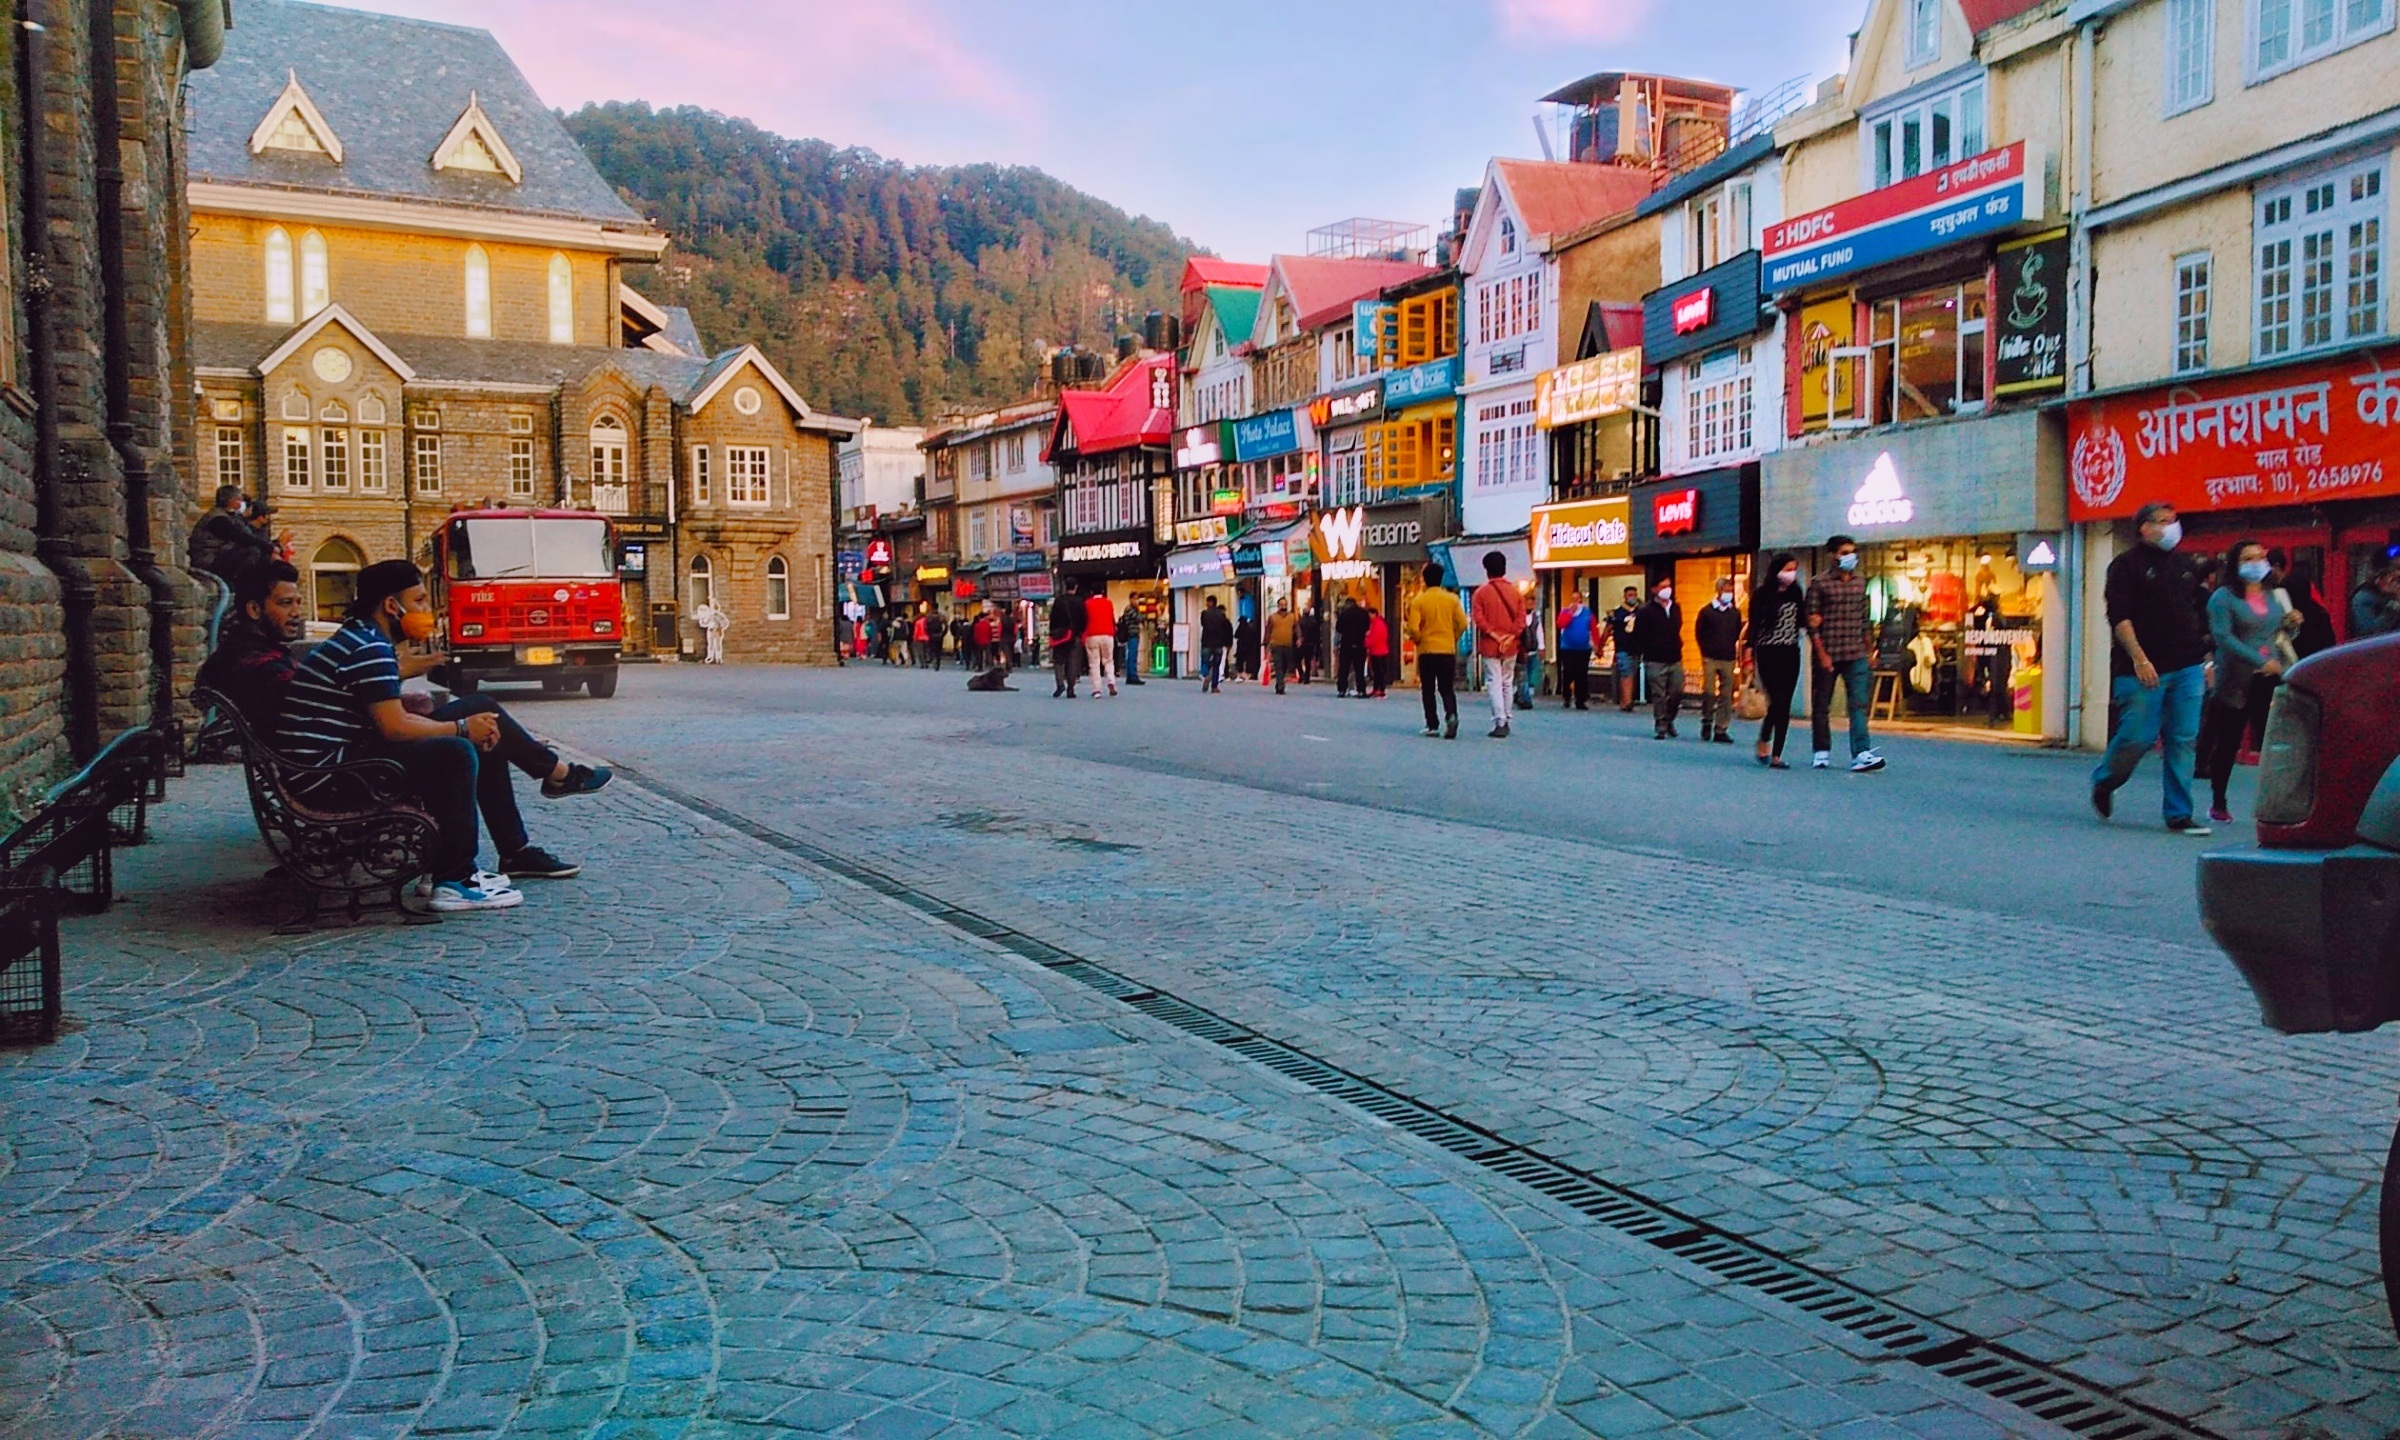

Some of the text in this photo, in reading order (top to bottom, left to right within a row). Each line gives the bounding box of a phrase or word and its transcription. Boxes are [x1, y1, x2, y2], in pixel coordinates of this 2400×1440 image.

[1785, 211, 1836, 246] HDFC
[1773, 247, 1854, 284] MUTUAL FUND
[2135, 383, 2332, 459] अग्निशमन
[2255, 438, 2324, 471] माल रोड
[2271, 471, 2301, 495] 101,
[2307, 460, 2384, 491] 2658976
[1847, 499, 1915, 526] adidas
[1550, 517, 1628, 547] Hideout Cafe
[471, 592, 495, 603] FIRE
